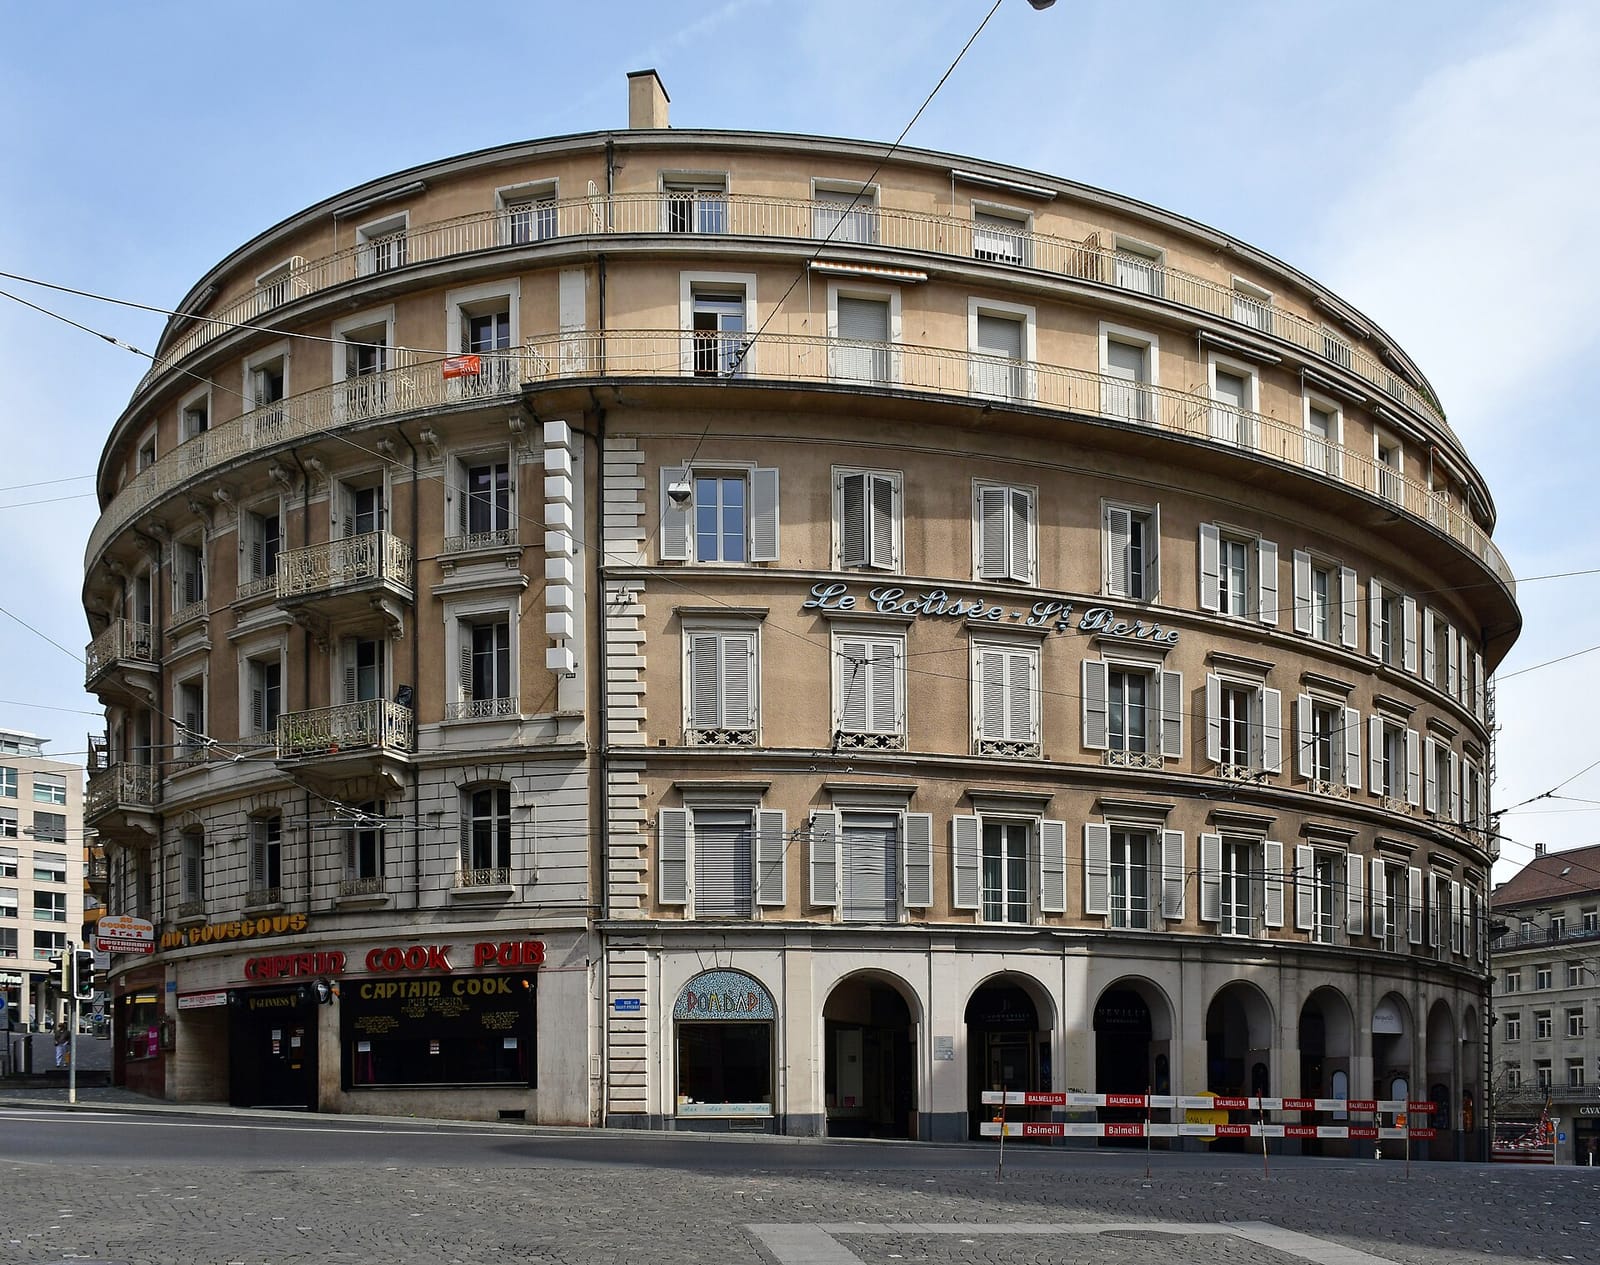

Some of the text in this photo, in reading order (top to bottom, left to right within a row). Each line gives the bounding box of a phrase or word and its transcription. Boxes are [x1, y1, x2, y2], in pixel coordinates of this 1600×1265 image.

[803, 583, 856, 610] Le
[1079, 607, 1179, 643] Pierre
[161, 913, 308, 948] AU COUSCOUS
[244, 940, 547, 981] CAPTAIN COOK PUB
[360, 977, 513, 1000] CAPTAIN COOK
[1580, 1106, 1600, 1115] CAVA
[1027, 1125, 1060, 1135] Balmelli
[1108, 1125, 1140, 1135] Balmelli
